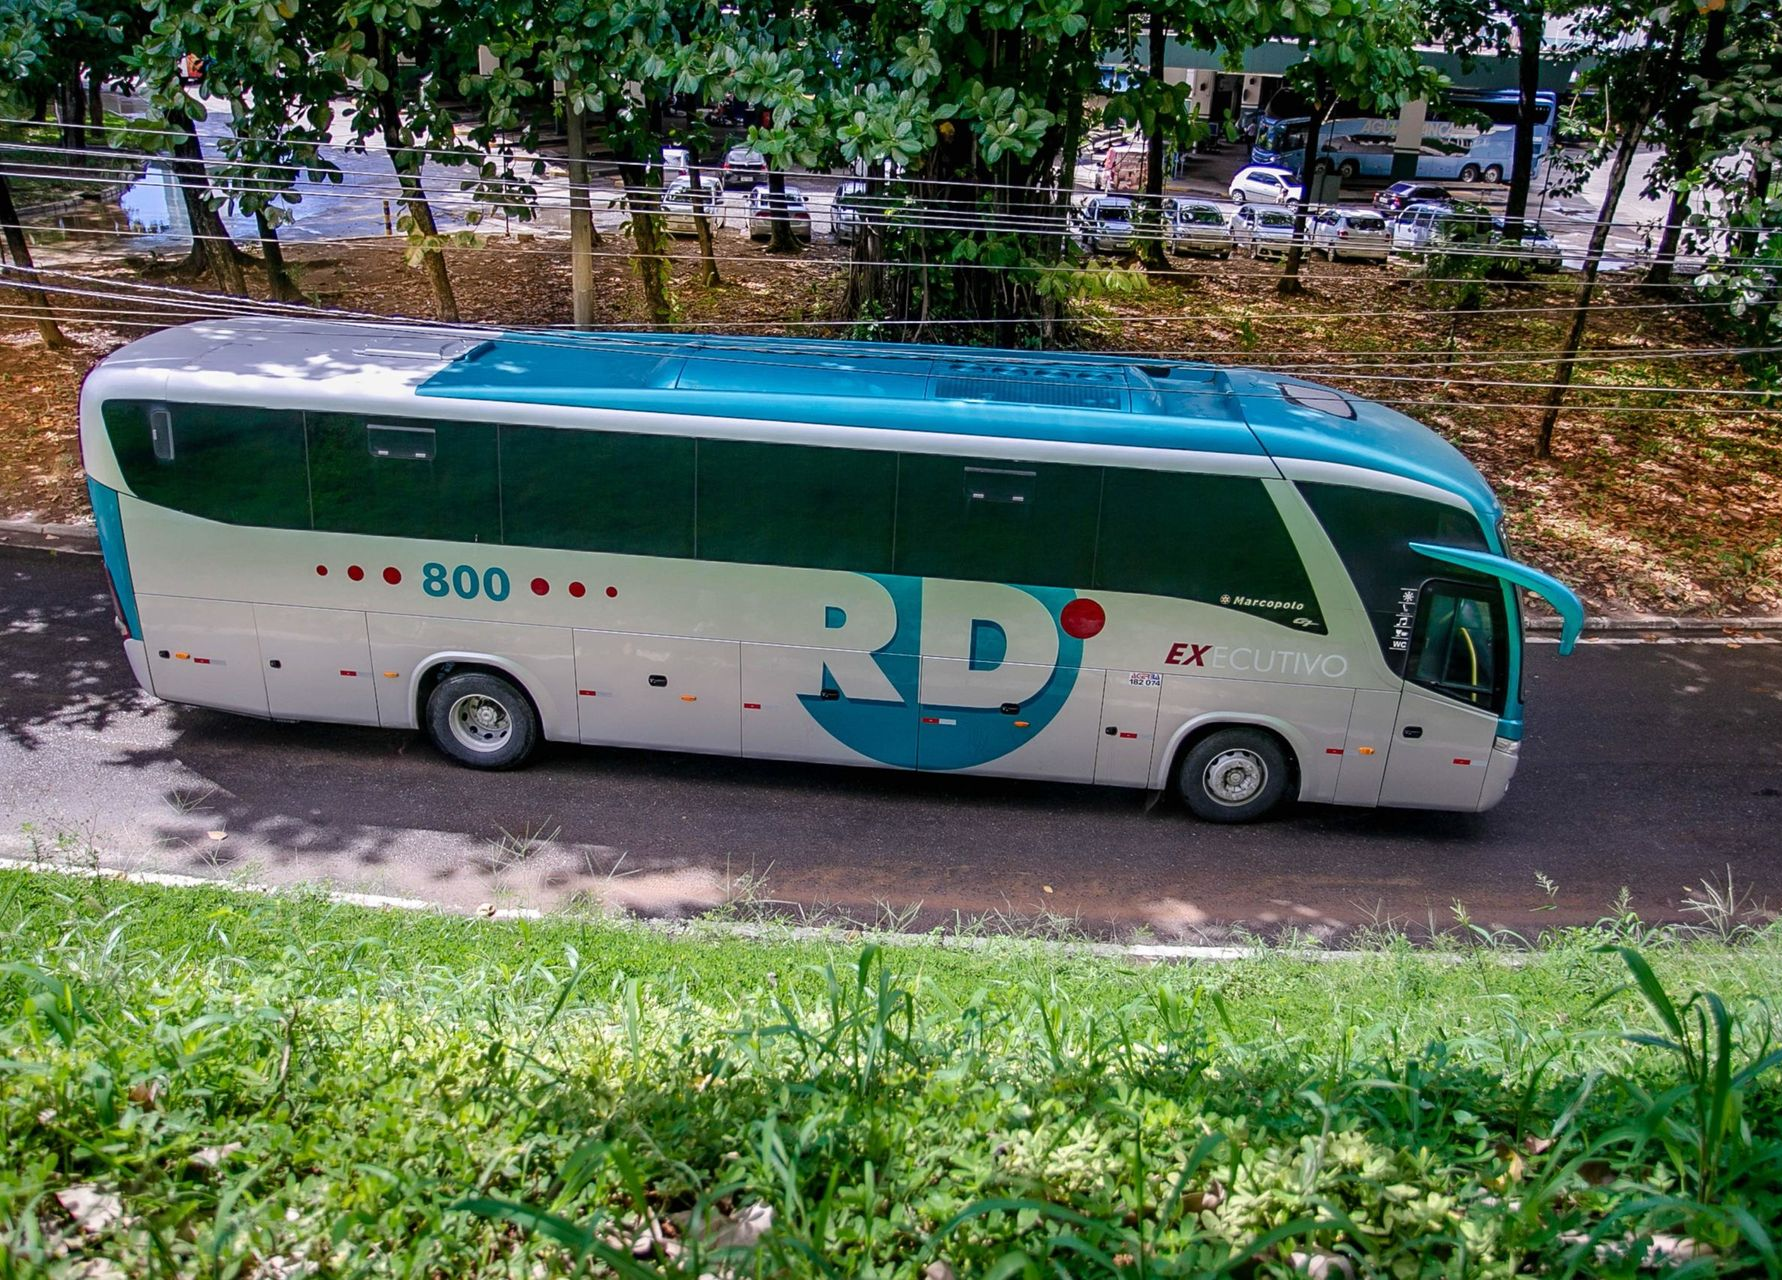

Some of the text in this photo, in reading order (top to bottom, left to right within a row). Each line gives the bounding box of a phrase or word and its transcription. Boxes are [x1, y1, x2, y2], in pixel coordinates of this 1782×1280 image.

[421, 562, 511, 602] 800
[1233, 596, 1304, 611] Marcopolo
[796, 570, 1064, 712] RD
[1392, 640, 1407, 649] WC
[1164, 642, 1348, 678] EXECUTIVO
[1129, 679, 1160, 687] 182 074
